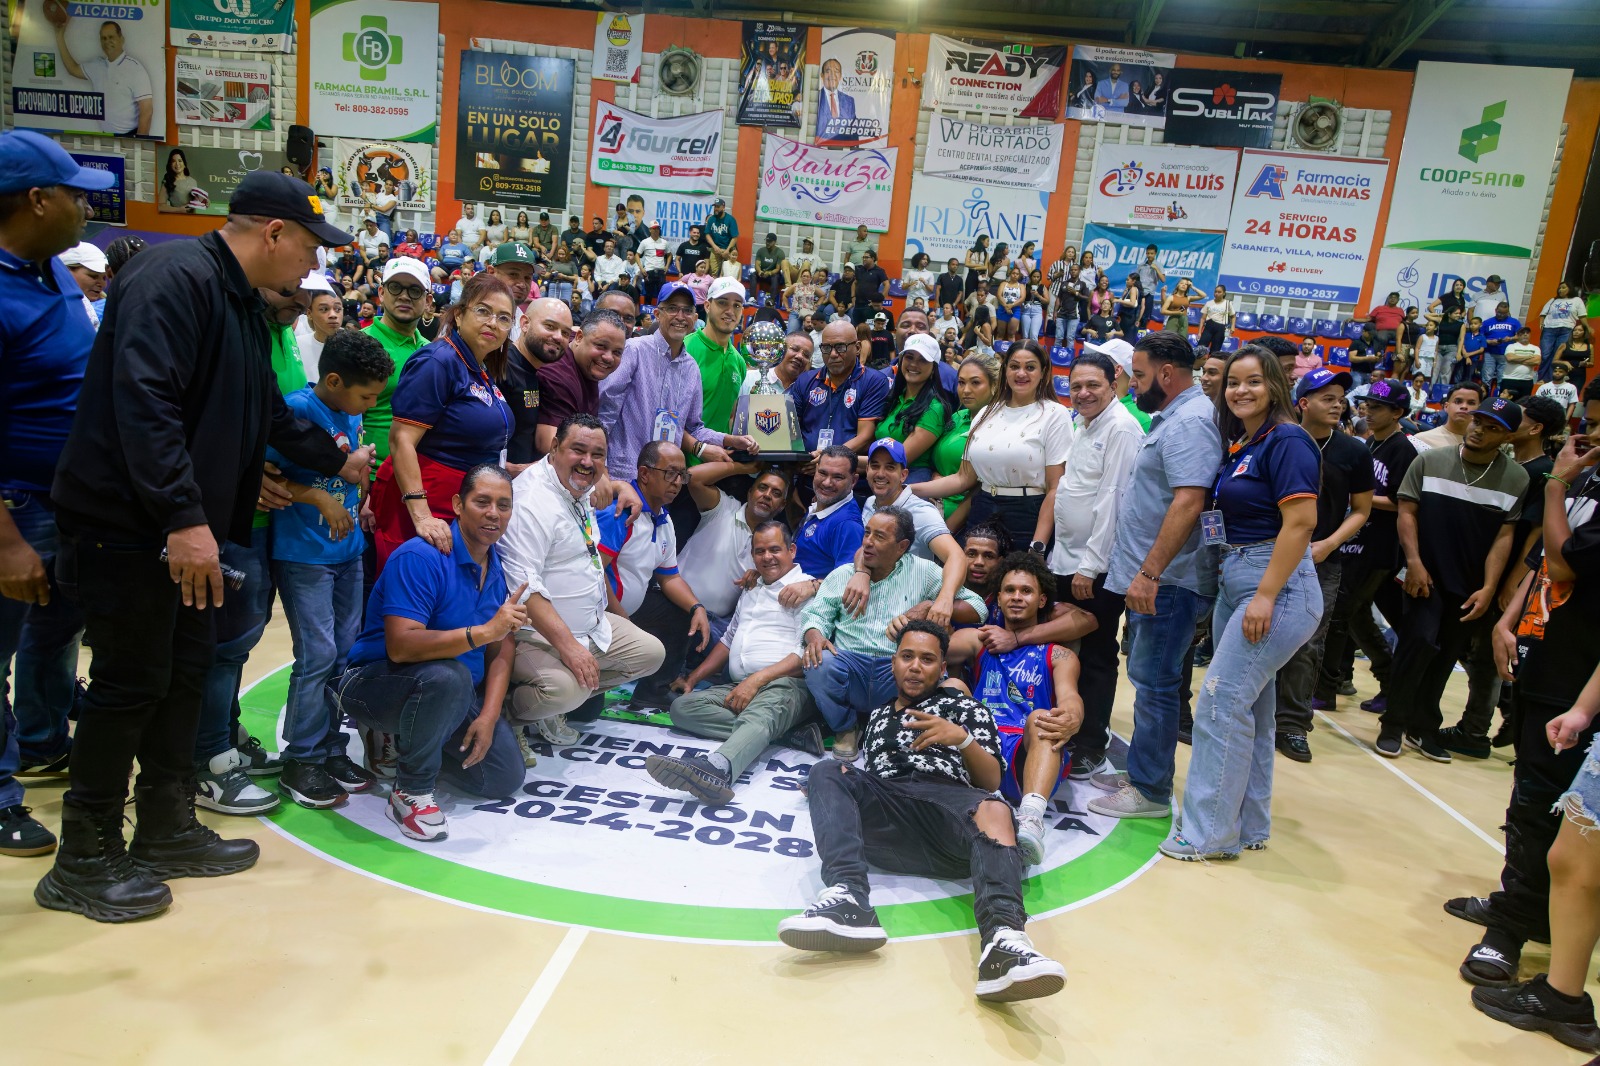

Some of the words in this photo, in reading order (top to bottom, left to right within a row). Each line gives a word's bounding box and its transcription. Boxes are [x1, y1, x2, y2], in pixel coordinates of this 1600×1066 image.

[74, 5, 135, 19] ALCALDE
[194, 14, 221, 23] GRUPO
[362, 35, 383, 62] FB
[177, 62, 202, 71] ESTRELLA
[945, 49, 1049, 79] READY
[205, 68, 213, 76] LA
[214, 70, 242, 79] ESTRELLA
[243, 72, 258, 80] ERES
[475, 61, 558, 92] BLOOM
[314, 81, 362, 94] FARMACIA
[403, 88, 430, 98] S.R.L.
[950, 77, 1022, 91] CONNECTION
[18, 91, 57, 113] APOYANDO
[58, 93, 68, 114] EL
[69, 94, 103, 116] DEPORTE
[335, 103, 350, 112] Tel:
[352, 104, 409, 116] 809-382-0595
[467, 111, 489, 125] EN
[493, 113, 515, 127] UN
[519, 115, 561, 131] SOLO
[828, 118, 880, 127] APOYANDO
[467, 125, 560, 153] LUGAR
[825, 126, 836, 134] EL
[841, 127, 881, 137] DEPORTE
[627, 127, 720, 155] Fourcell
[968, 131, 1051, 151] HURTADO
[937, 148, 965, 160] CENTRO
[966, 152, 993, 163] DENTAL
[995, 155, 1050, 166] ESPECIALIZADO
[209, 175, 230, 183] Dra.
[794, 175, 846, 188] ACCESORIOS
[1144, 171, 1179, 189] SAN
[1297, 169, 1371, 187] Farmacia
[495, 182, 542, 193] 809-733-2518
[1291, 183, 1371, 200] ANANIAS
[1441, 188, 1464, 196] Aliada
[402, 201, 426, 209] Franco
[656, 200, 714, 221] MANNY
[1279, 212, 1328, 224] SERVICIO
[1244, 218, 1271, 236] 24
[1278, 222, 1357, 243] HORAS
[1230, 242, 1283, 255] SABANETA,
[1285, 247, 1314, 258] VILLA,
[1316, 250, 1365, 261] MONCIÓN.
[1290, 266, 1324, 275] DELIVERY
[1264, 284, 1286, 294] 809
[1287, 286, 1340, 300] 580-2837
[1488, 323, 1512, 331] LACOSTE
[877, 437, 895, 448] CPA
[472, 795, 815, 859] 2024-2028
[1479, 946, 1505, 959] NIKE
